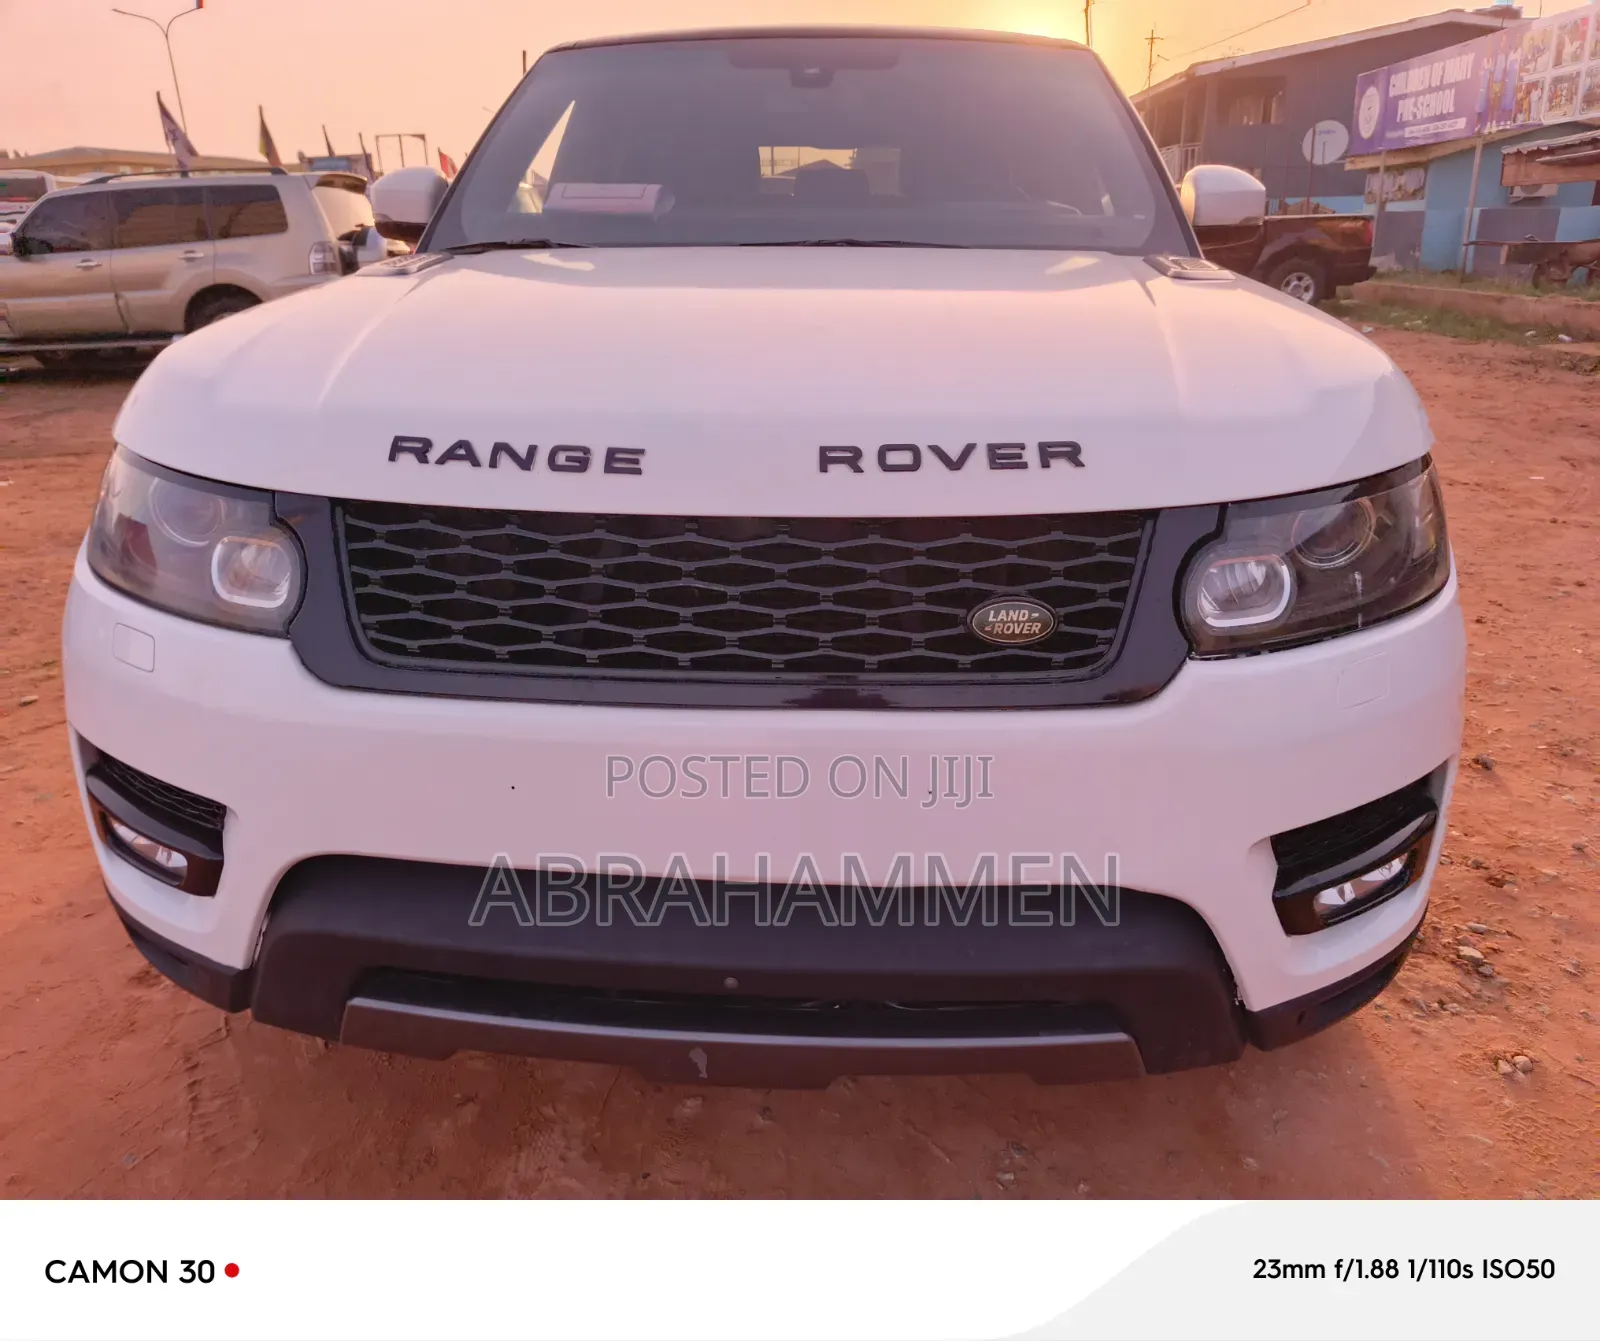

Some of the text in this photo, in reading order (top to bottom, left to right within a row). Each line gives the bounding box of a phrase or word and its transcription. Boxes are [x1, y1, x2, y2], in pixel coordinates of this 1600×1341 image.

[1430, 61, 1445, 88] OF
[388, 435, 1085, 475] RANGE ROVER
